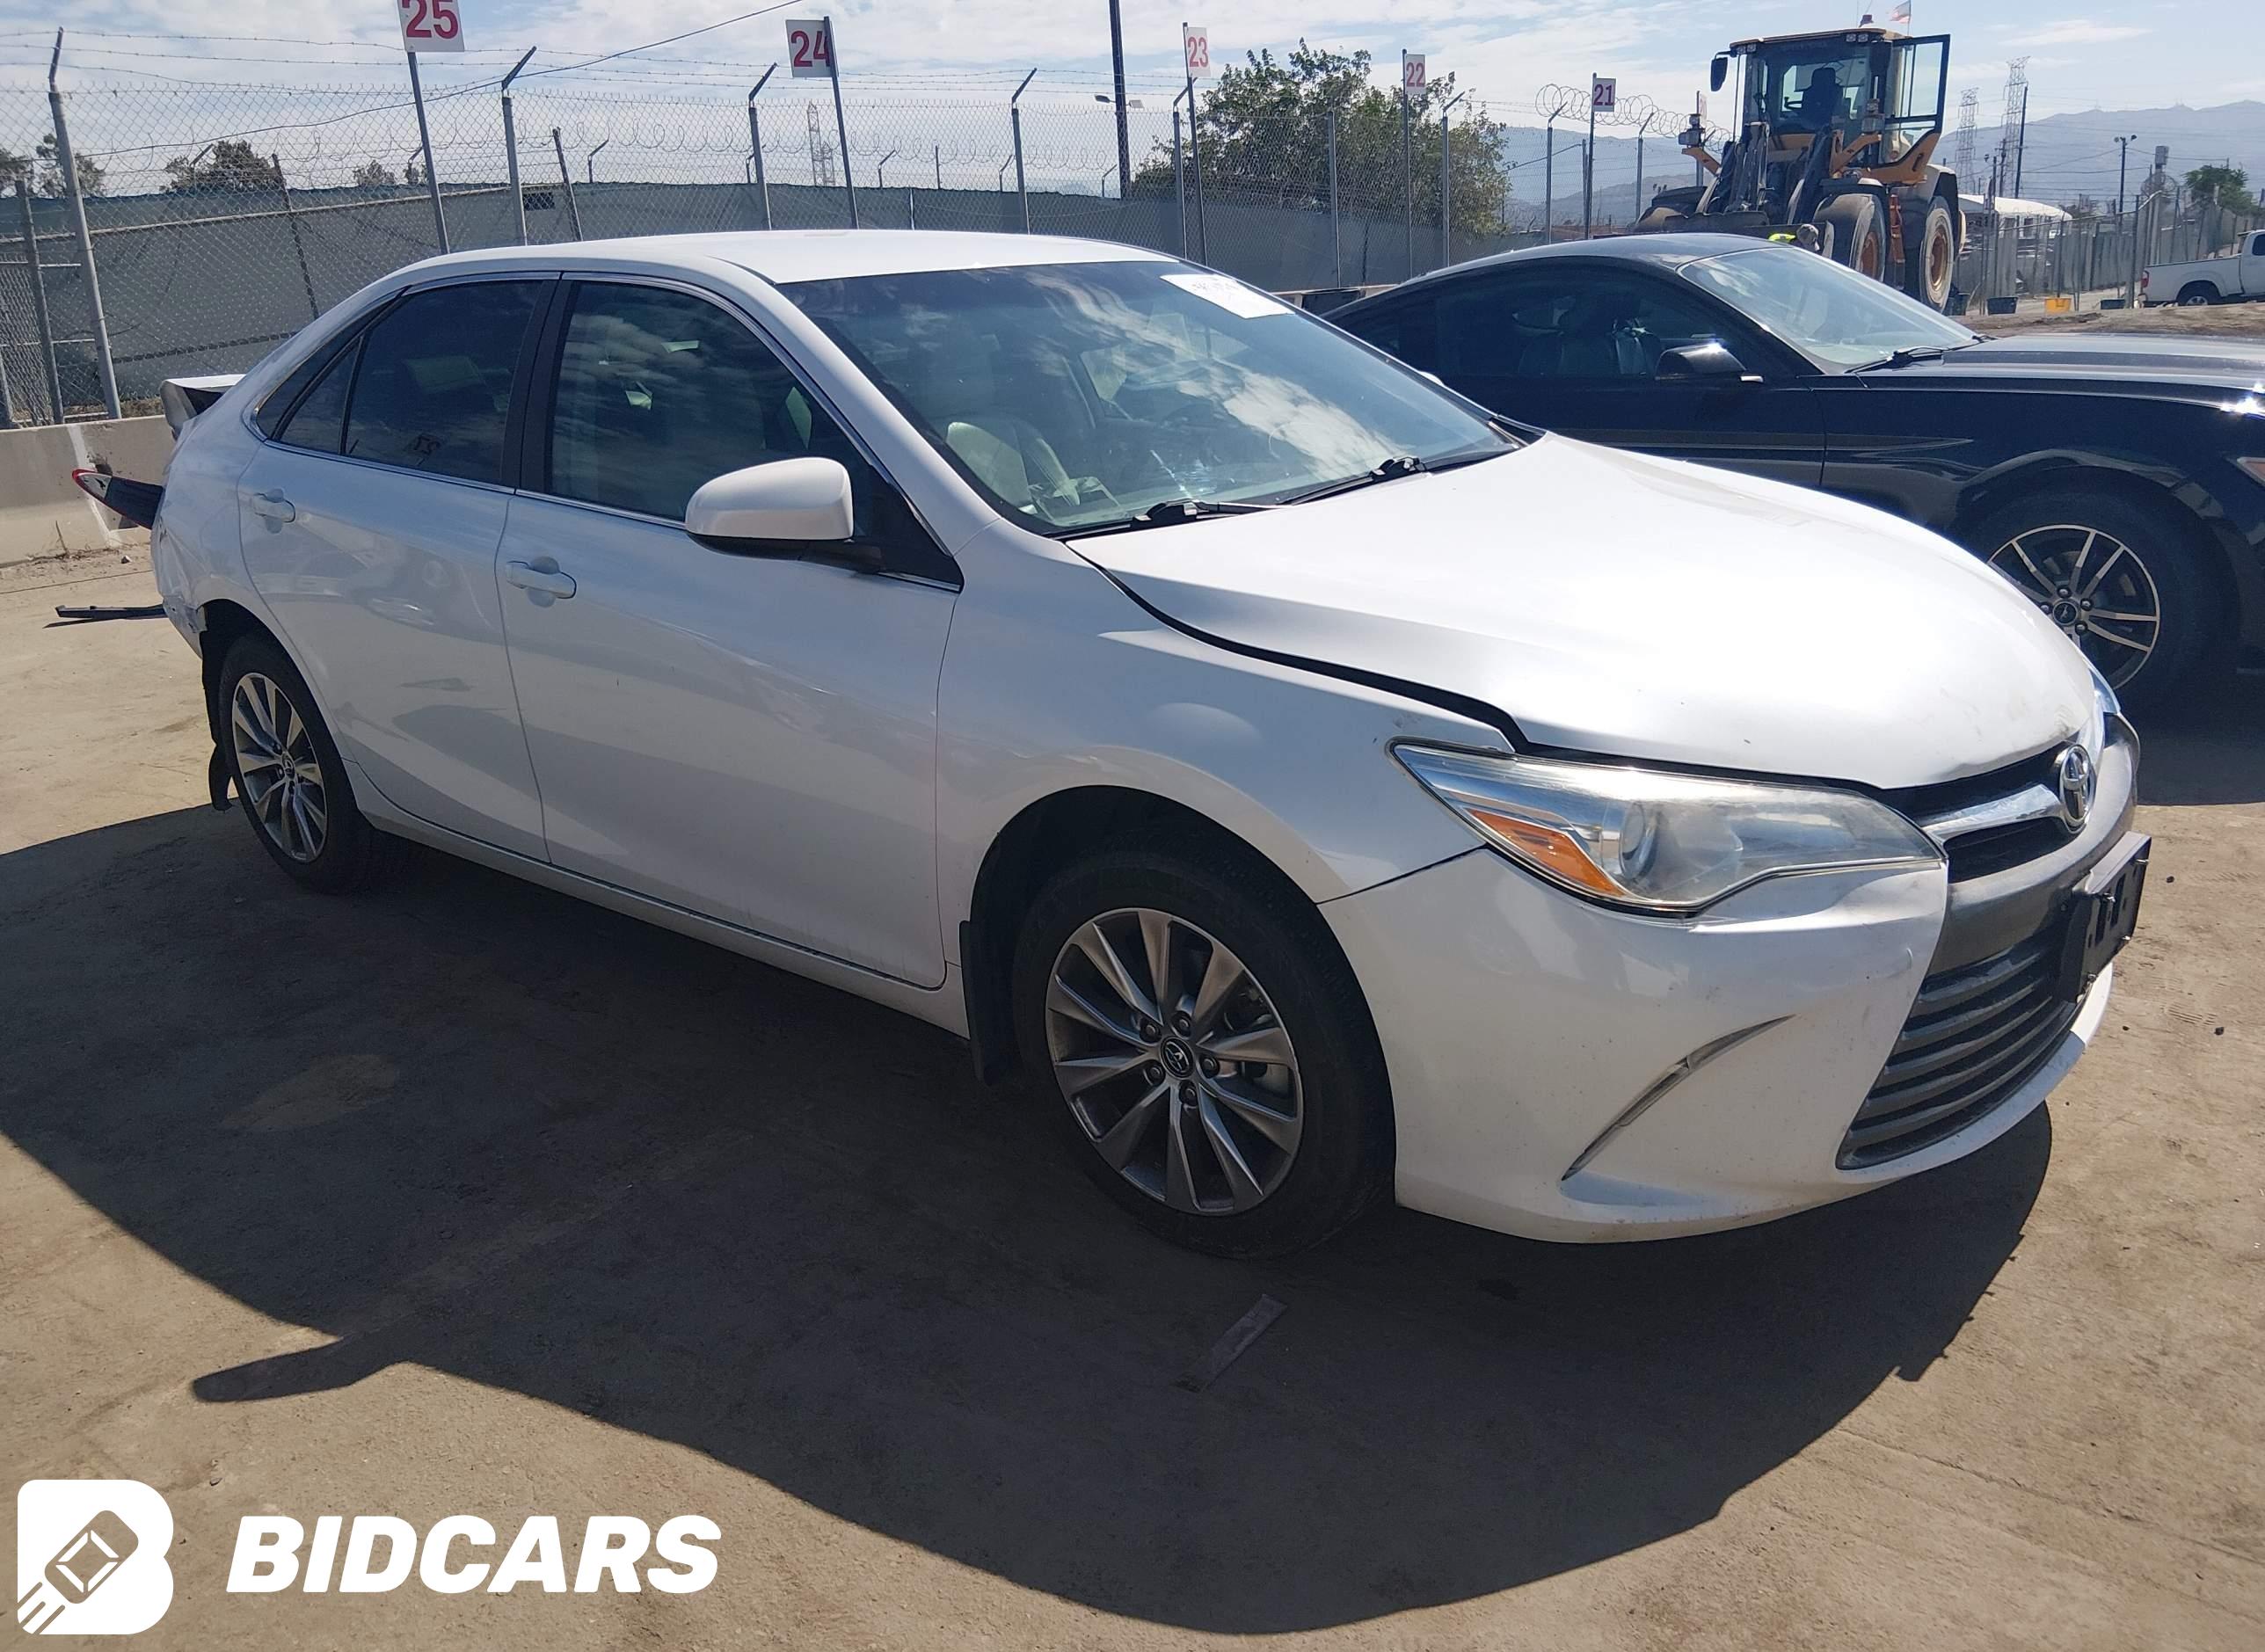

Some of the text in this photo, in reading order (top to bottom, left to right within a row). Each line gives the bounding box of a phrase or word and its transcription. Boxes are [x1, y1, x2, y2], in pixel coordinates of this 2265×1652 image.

[402, 0, 458, 39] 25
[790, 30, 830, 68] 24
[1187, 36, 1208, 68] 23
[1406, 62, 1424, 87] 22
[1593, 84, 1614, 106] 21
